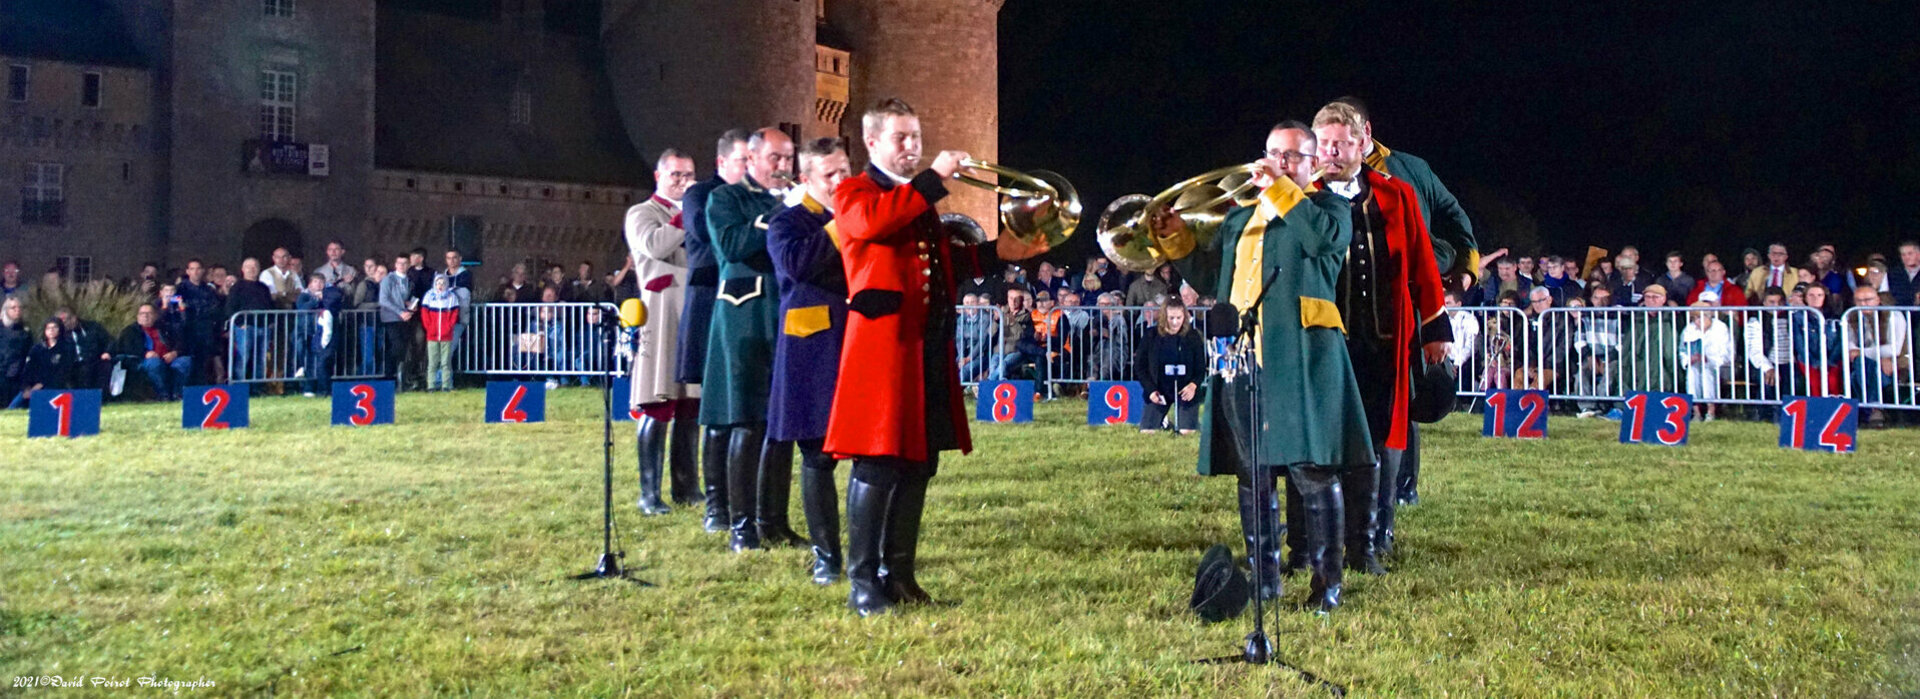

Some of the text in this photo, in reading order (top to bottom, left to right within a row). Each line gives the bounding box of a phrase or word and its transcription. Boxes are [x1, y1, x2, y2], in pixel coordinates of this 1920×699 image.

[50, 392, 72, 436] 1
[201, 388, 230, 429] 2
[350, 384, 376, 425] 3
[502, 385, 527, 423] 4
[992, 383, 1017, 422] 8
[1105, 385, 1129, 425] 9
[1486, 392, 1545, 438] 12
[1625, 394, 1689, 445] 13
[1782, 399, 1852, 453] 14
